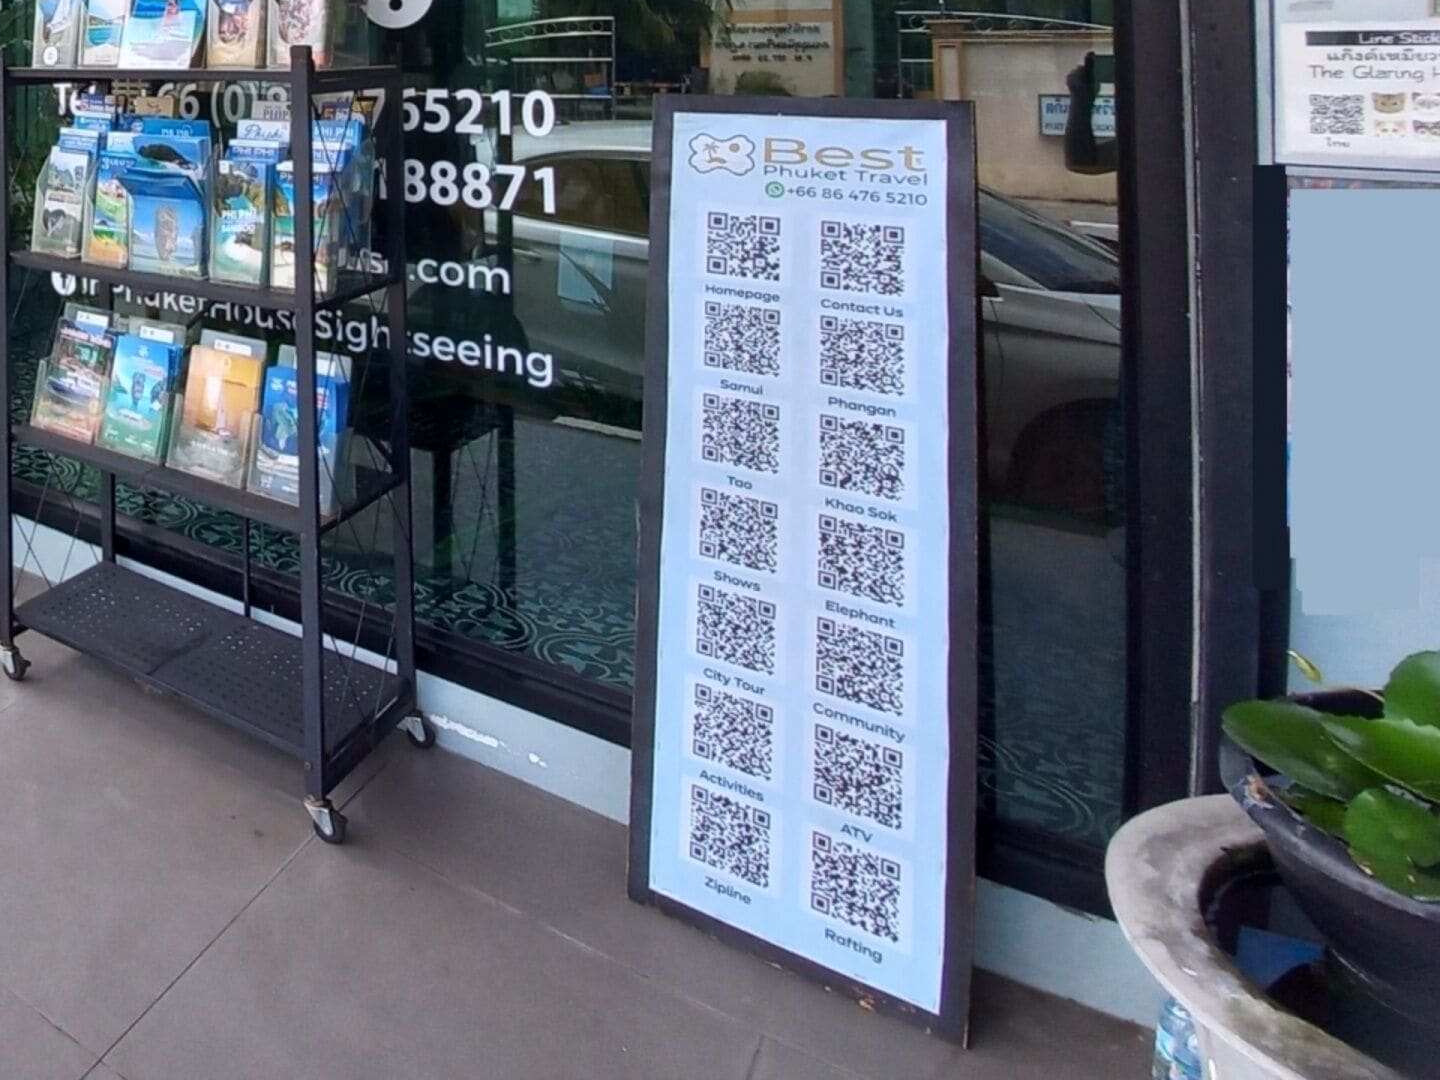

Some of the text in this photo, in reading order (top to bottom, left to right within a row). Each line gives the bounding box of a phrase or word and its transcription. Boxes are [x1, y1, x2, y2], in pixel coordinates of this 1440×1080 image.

[1359, 33, 1395, 44] Line
[1308, 65, 1344, 79] The
[1352, 65, 1424, 83] Glaring
[763, 137, 926, 172] Best
[763, 165, 929, 186] Phuket Travel
[787, 186, 928, 207] +66 86 476 5210
[705, 284, 781, 304] Homepage
[820, 298, 904, 319] Contact Us
[315, 309, 553, 388] Sighseeing
[720, 379, 763, 395] Samui
[828, 396, 896, 418] Phangan
[727, 475, 753, 490] Tao
[824, 497, 898, 522] Khao Sok
[713, 570, 761, 592] Shows
[825, 600, 896, 629] Elephant
[703, 667, 766, 695] City Tour
[813, 702, 906, 744] Community
[699, 770, 764, 802] Activities
[841, 824, 873, 844] ATV
[704, 876, 751, 905] Zipline
[825, 928, 884, 964] Rafting
